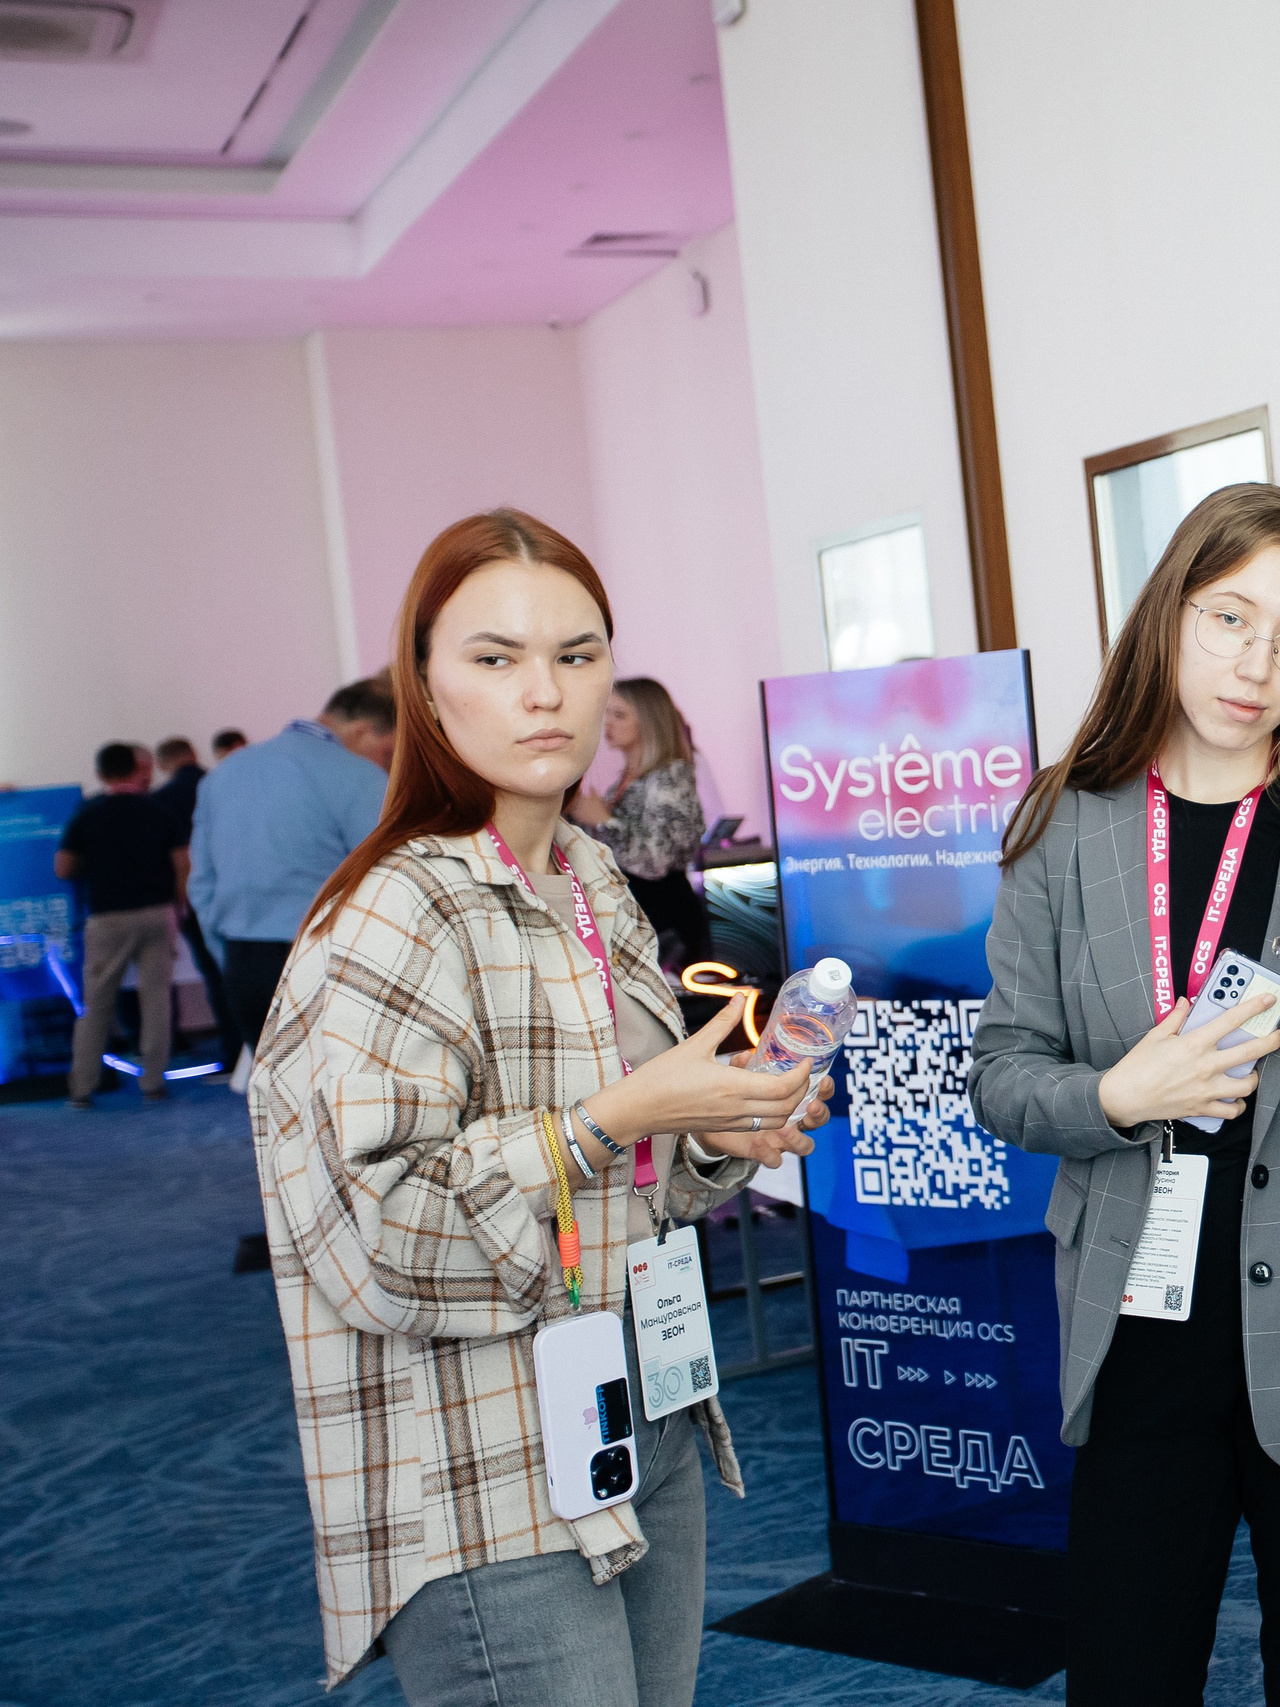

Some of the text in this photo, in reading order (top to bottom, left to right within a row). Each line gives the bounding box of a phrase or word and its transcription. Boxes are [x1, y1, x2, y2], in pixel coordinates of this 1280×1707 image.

[779, 732, 1022, 811] Systême
[1151, 788, 1167, 864] IT-СРЕДА
[1234, 797, 1253, 828] OCS
[784, 845, 1004, 875] Энергия. Технологии. Надежно
[1153, 882, 1167, 917] OCS
[1206, 847, 1239, 923] IT-СРЕДА
[1194, 940, 1212, 975] OCS
[1154, 936, 1173, 1015] IT-СРЕДА
[657, 1292, 683, 1310] Ольга
[836, 1288, 962, 1316] ПАРТНЕРСКАЯ
[661, 1323, 687, 1342] ЗЕОН
[838, 1311, 1016, 1344] КОНФЕРЕНЦИЯ OCS
[840, 1337, 890, 1391] IT
[847, 1416, 1046, 1494] СРЕДА
